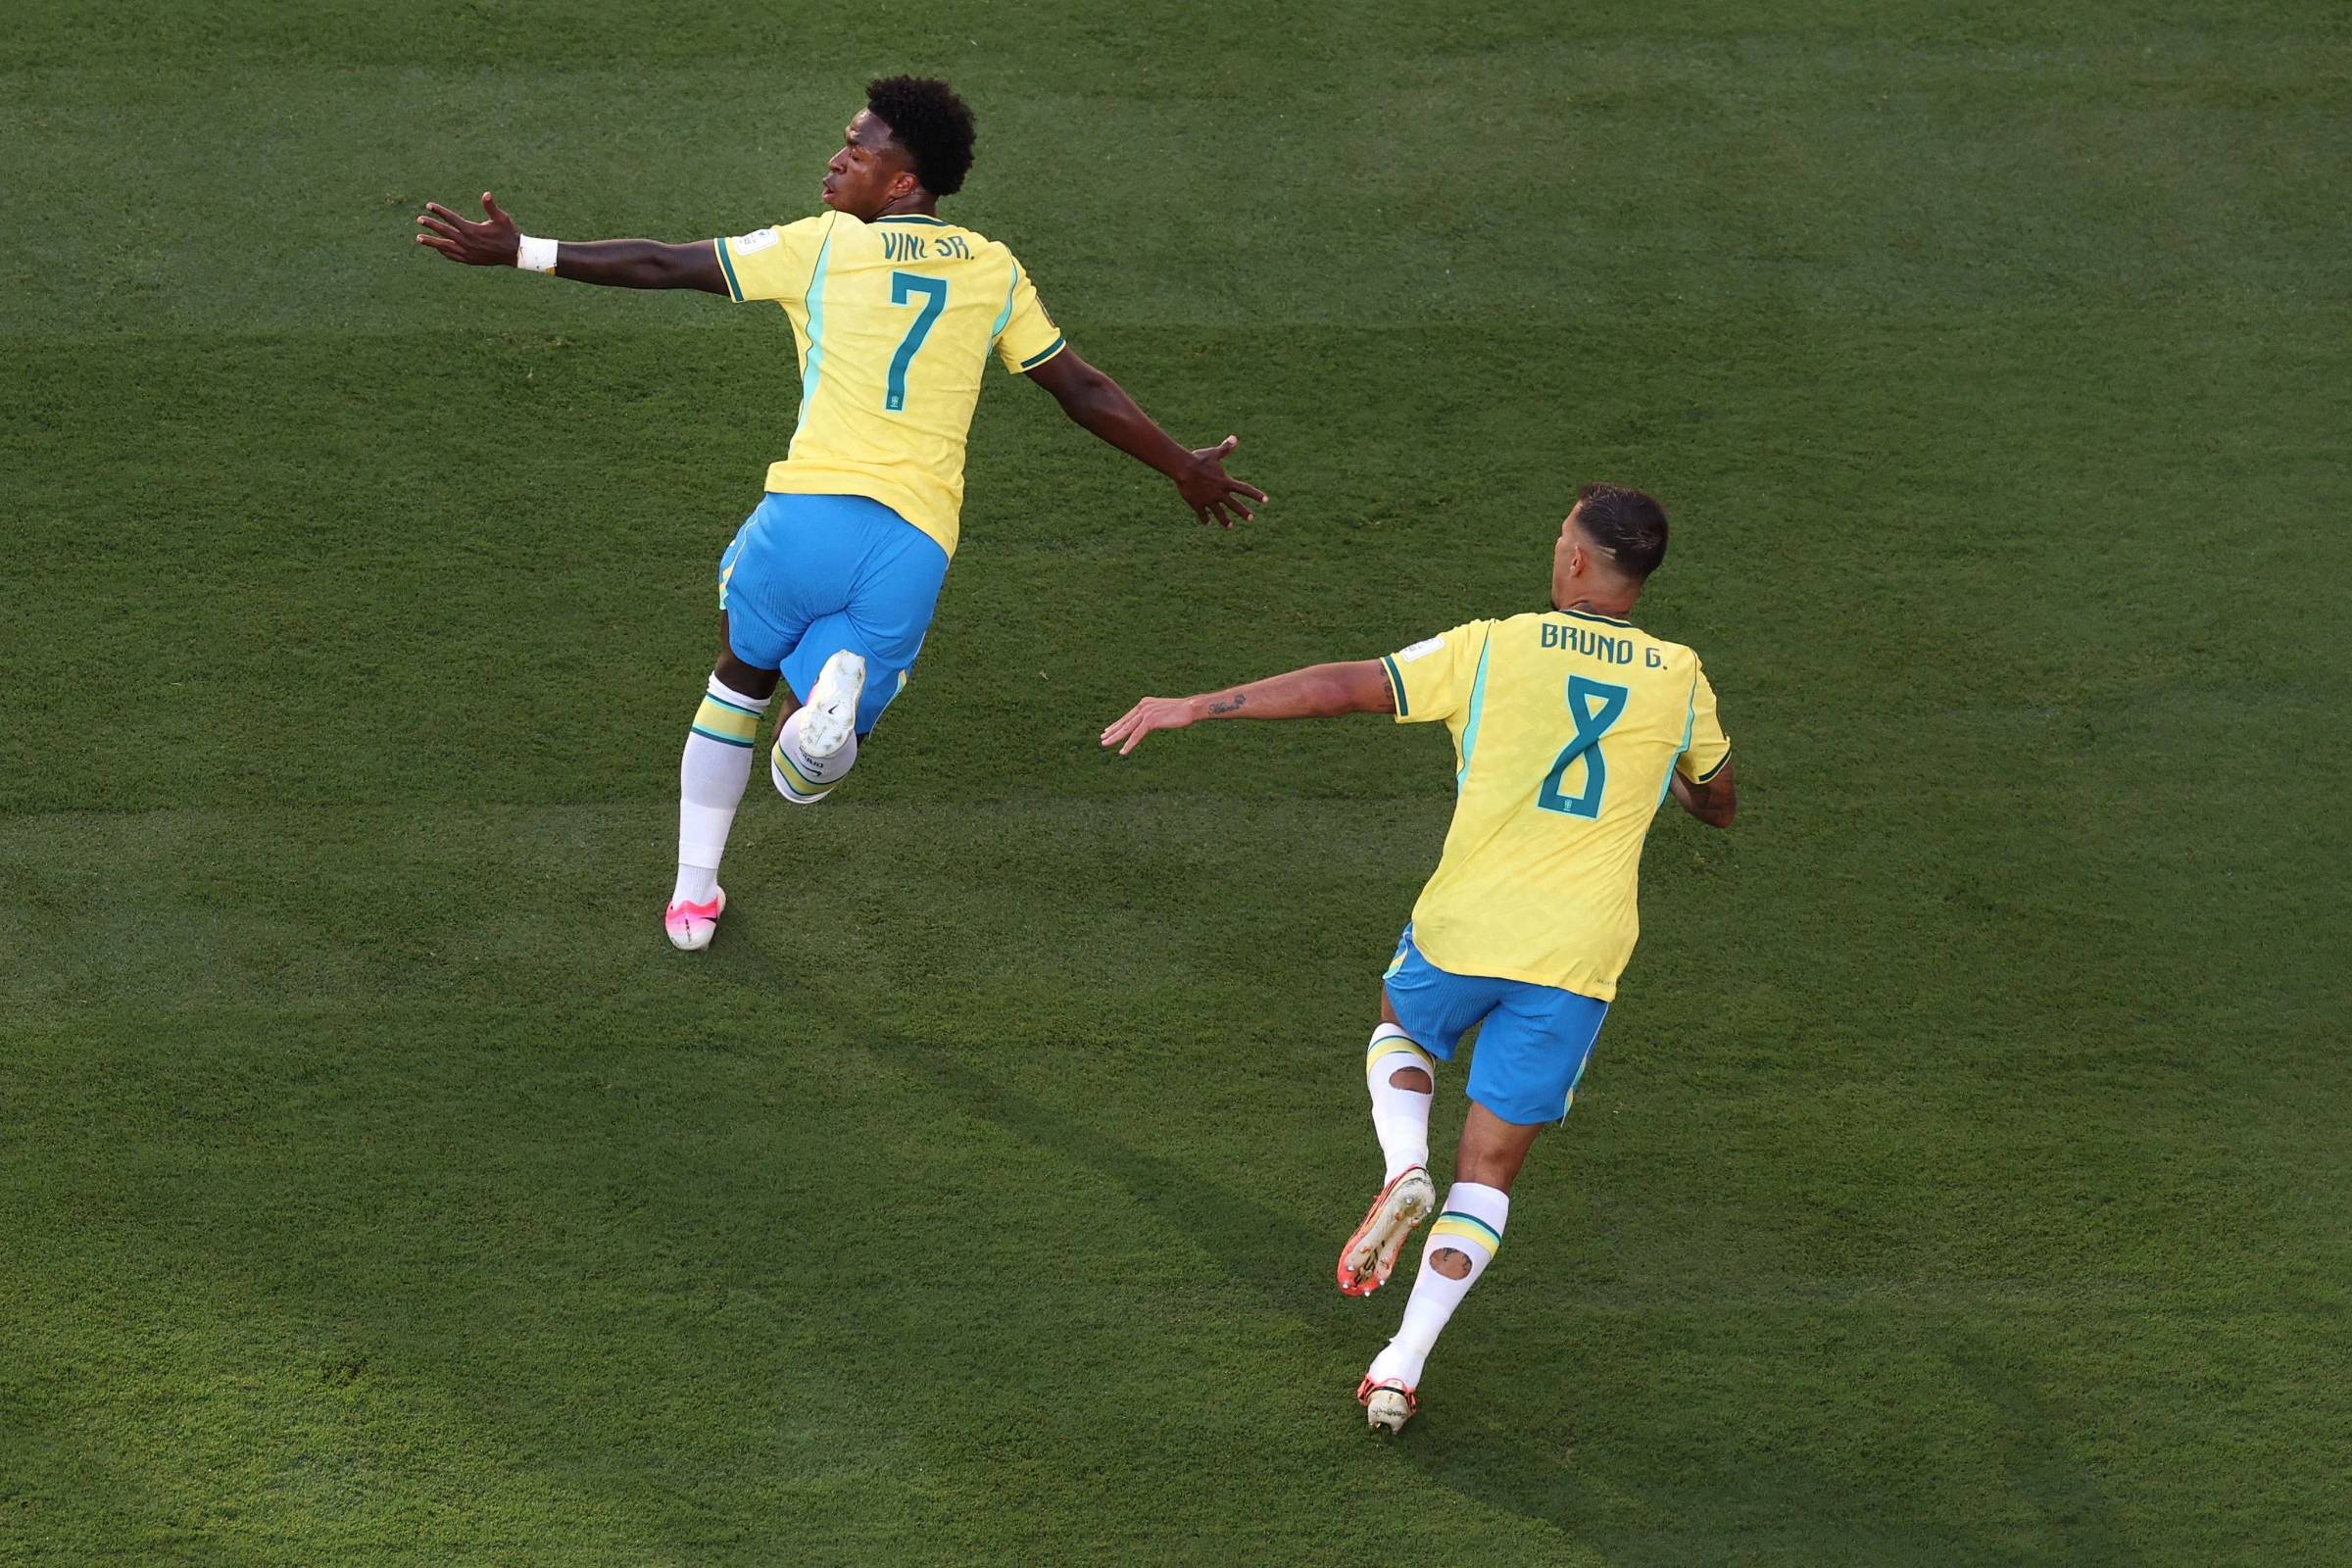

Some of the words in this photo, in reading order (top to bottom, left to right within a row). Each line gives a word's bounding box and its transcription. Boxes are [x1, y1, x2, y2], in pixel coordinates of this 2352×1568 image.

[934, 235, 975, 261] JR.
[885, 270, 948, 412] 7
[1541, 622, 1634, 665] BRUNO
[1645, 646, 1669, 671] G.
[1536, 673, 1629, 820] 8
